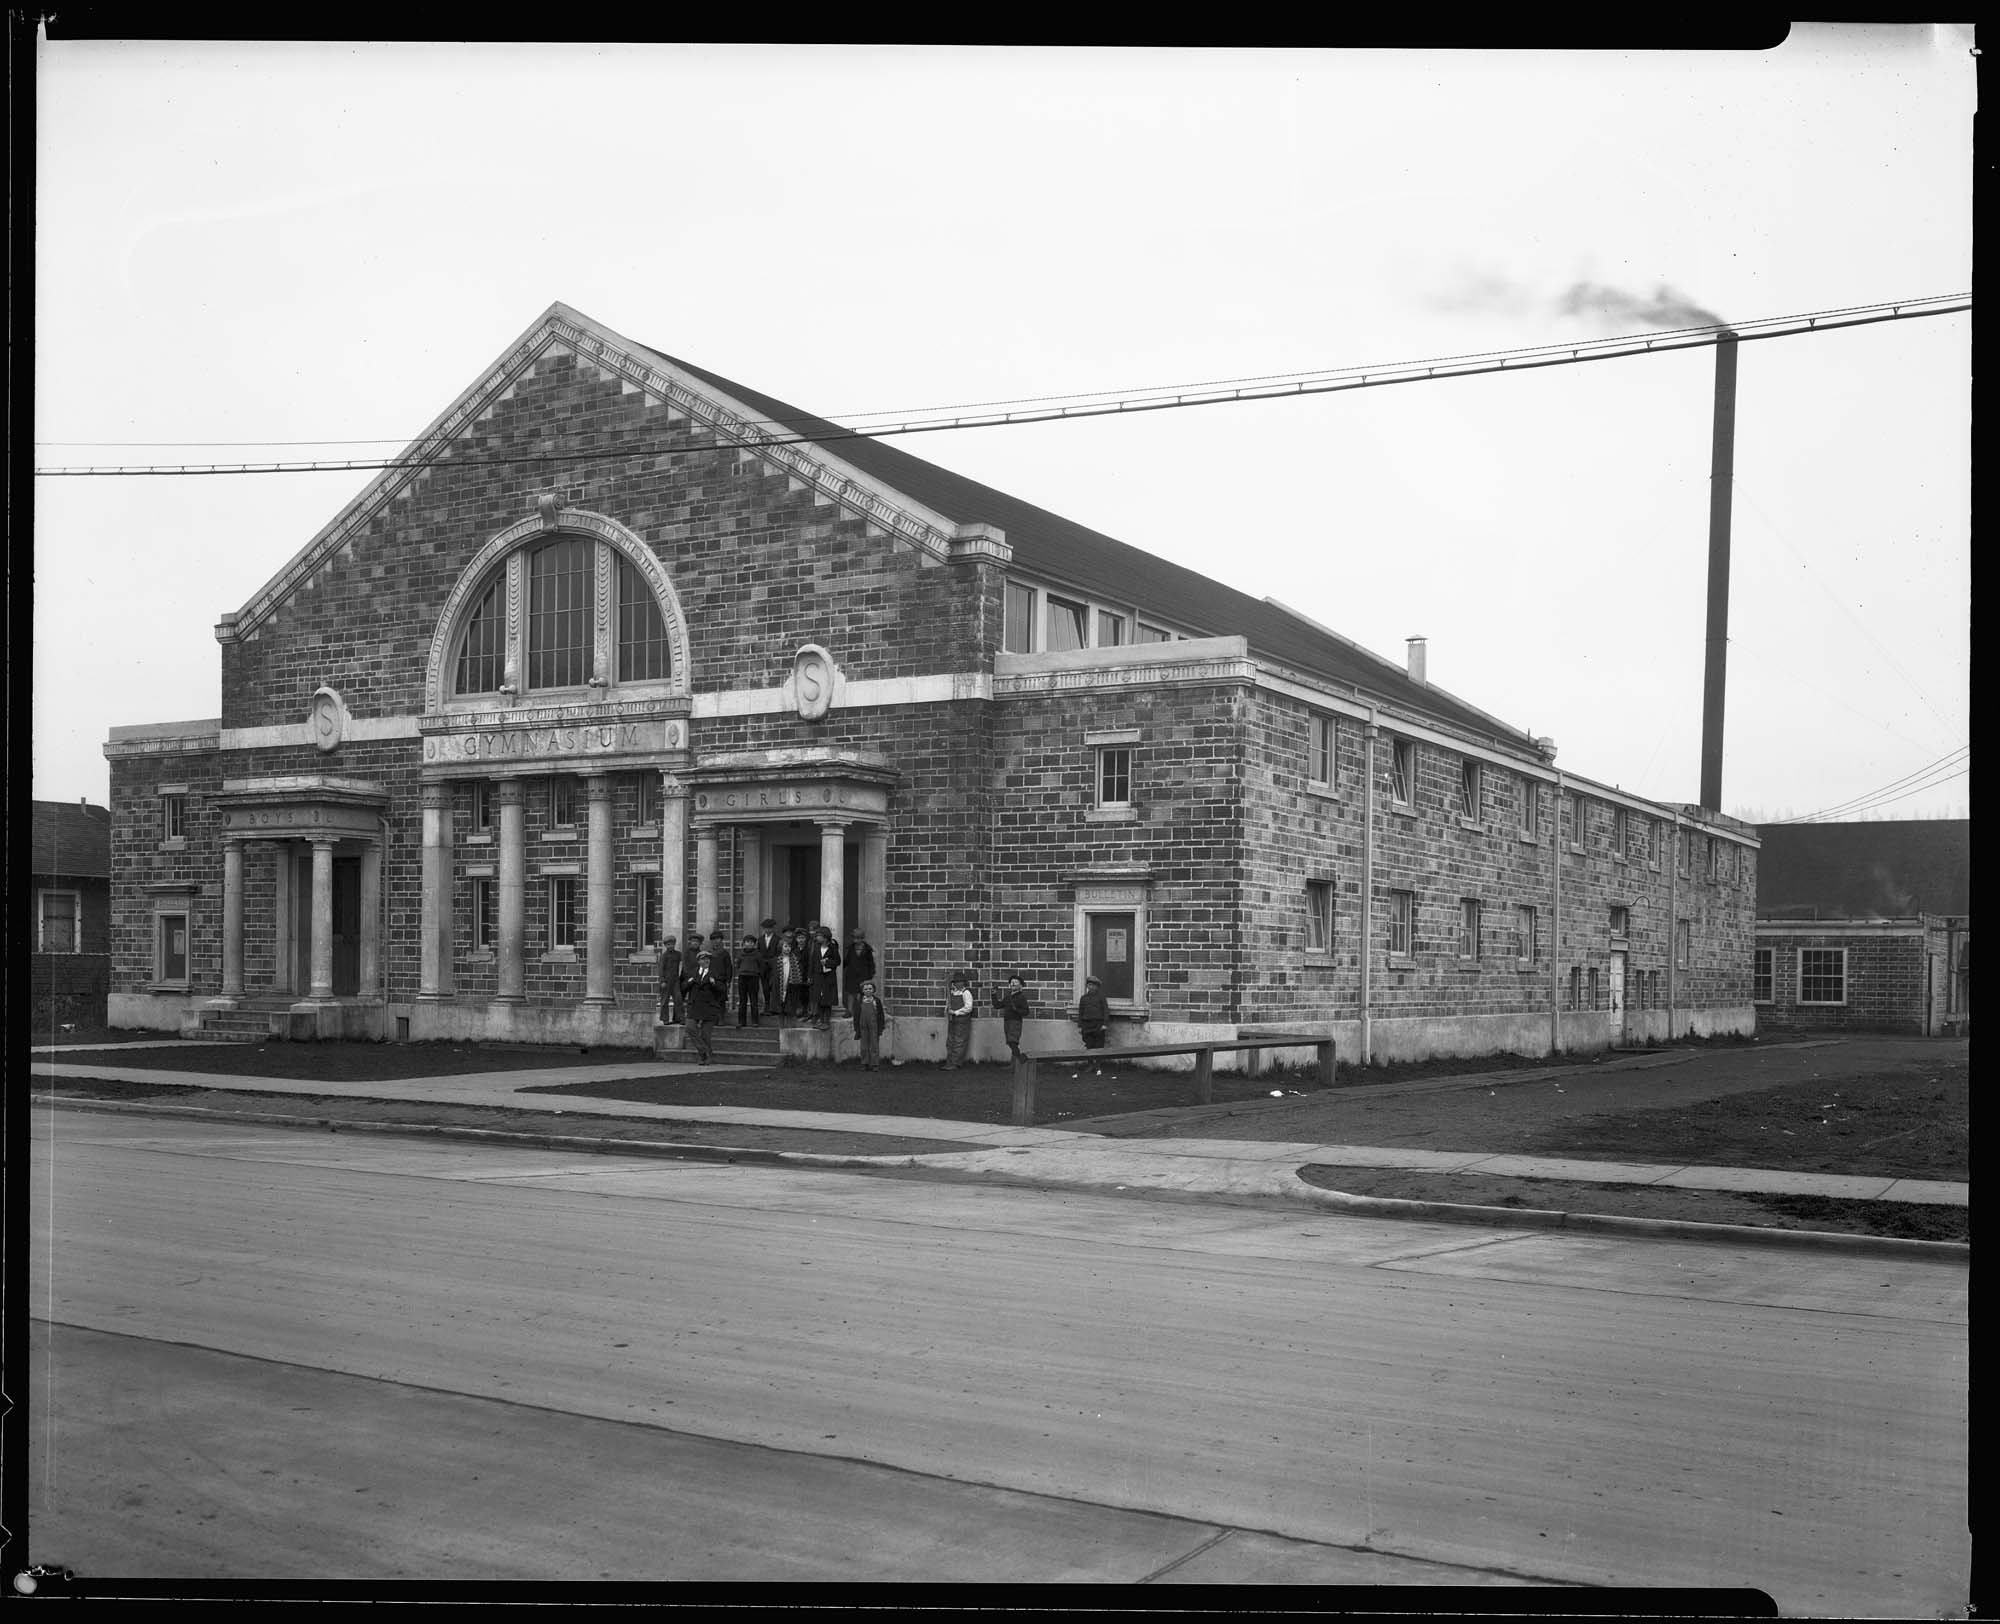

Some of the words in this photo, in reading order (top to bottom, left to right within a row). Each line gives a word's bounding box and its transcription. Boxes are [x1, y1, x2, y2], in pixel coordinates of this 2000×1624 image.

[803, 662, 820, 702] S
[320, 703, 333, 737] S
[463, 725, 639, 756] GYMNASIUM
[726, 790, 801, 807] GIRLS
[249, 811, 294, 825] BOYS
